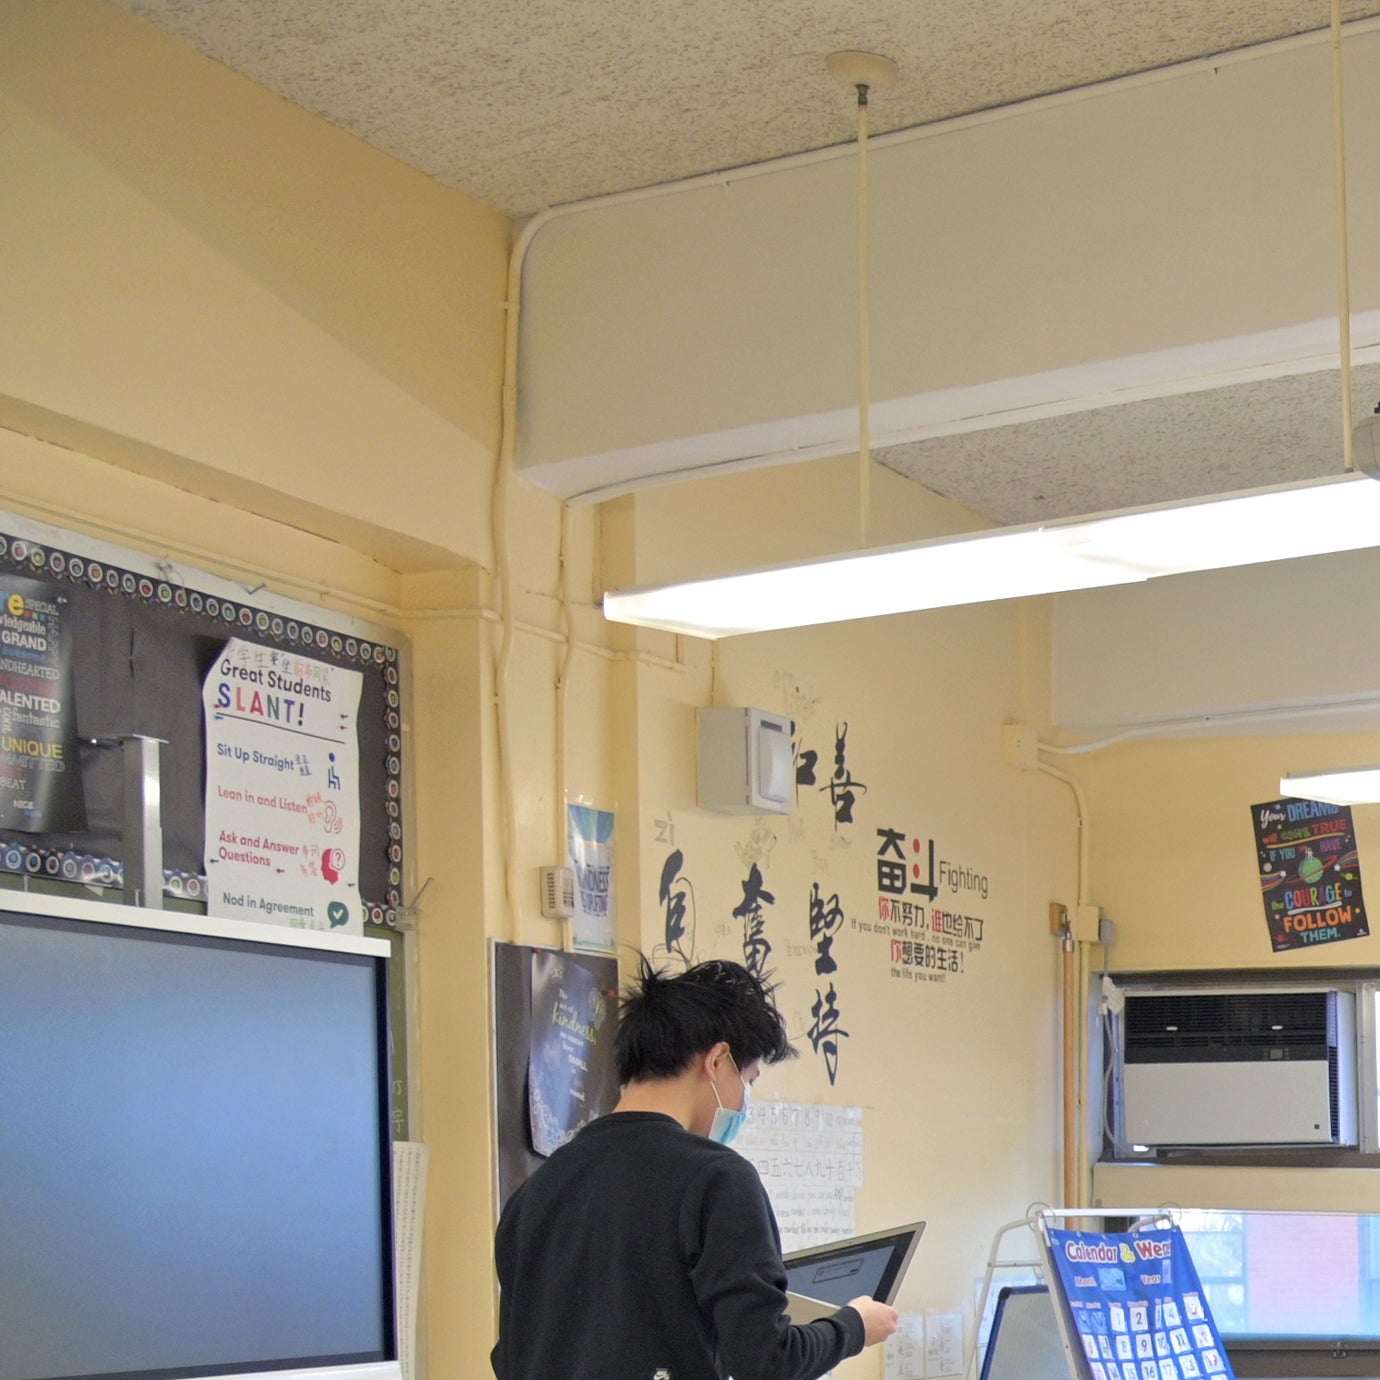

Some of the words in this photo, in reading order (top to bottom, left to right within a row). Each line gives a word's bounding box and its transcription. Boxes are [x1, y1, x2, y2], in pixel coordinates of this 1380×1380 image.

[2, 630, 47, 651] GRAND
[221, 659, 263, 685] Great
[268, 670, 332, 702] Students
[218, 683, 304, 726] SLANT!
[2, 736, 63, 759] UNIQUE
[217, 743, 232, 757] Sit
[234, 747, 250, 763] Up
[253, 751, 294, 771] Straight
[218, 785, 242, 800] Lean
[245, 790, 255, 804] in
[257, 796, 276, 808] and
[279, 798, 308, 814] Listen
[1260, 809, 1286, 829] Your
[1311, 819, 1347, 835] TRUE
[219, 830, 236, 844] Ask
[240, 835, 260, 849] and
[263, 839, 299, 855] Answer
[1269, 850, 1277, 862] IF
[1279, 847, 1295, 860] YOU
[1320, 838, 1341, 852] HAVE
[219, 847, 271, 867] Questions
[877, 828, 938, 902] 奋斗
[939, 861, 988, 899] Fighting
[223, 893, 244, 907] Nod
[247, 895, 256, 909] in
[259, 898, 314, 917] Agreement
[1284, 882, 1342, 910] COURAGE
[858, 921, 872, 932] you
[893, 928, 908, 938] work
[1283, 905, 1353, 933] FOLLOW
[1300, 927, 1341, 943] THEM.
[1066, 1240, 1118, 1264] Calendar
[1136, 1312, 1142, 1326] 2
